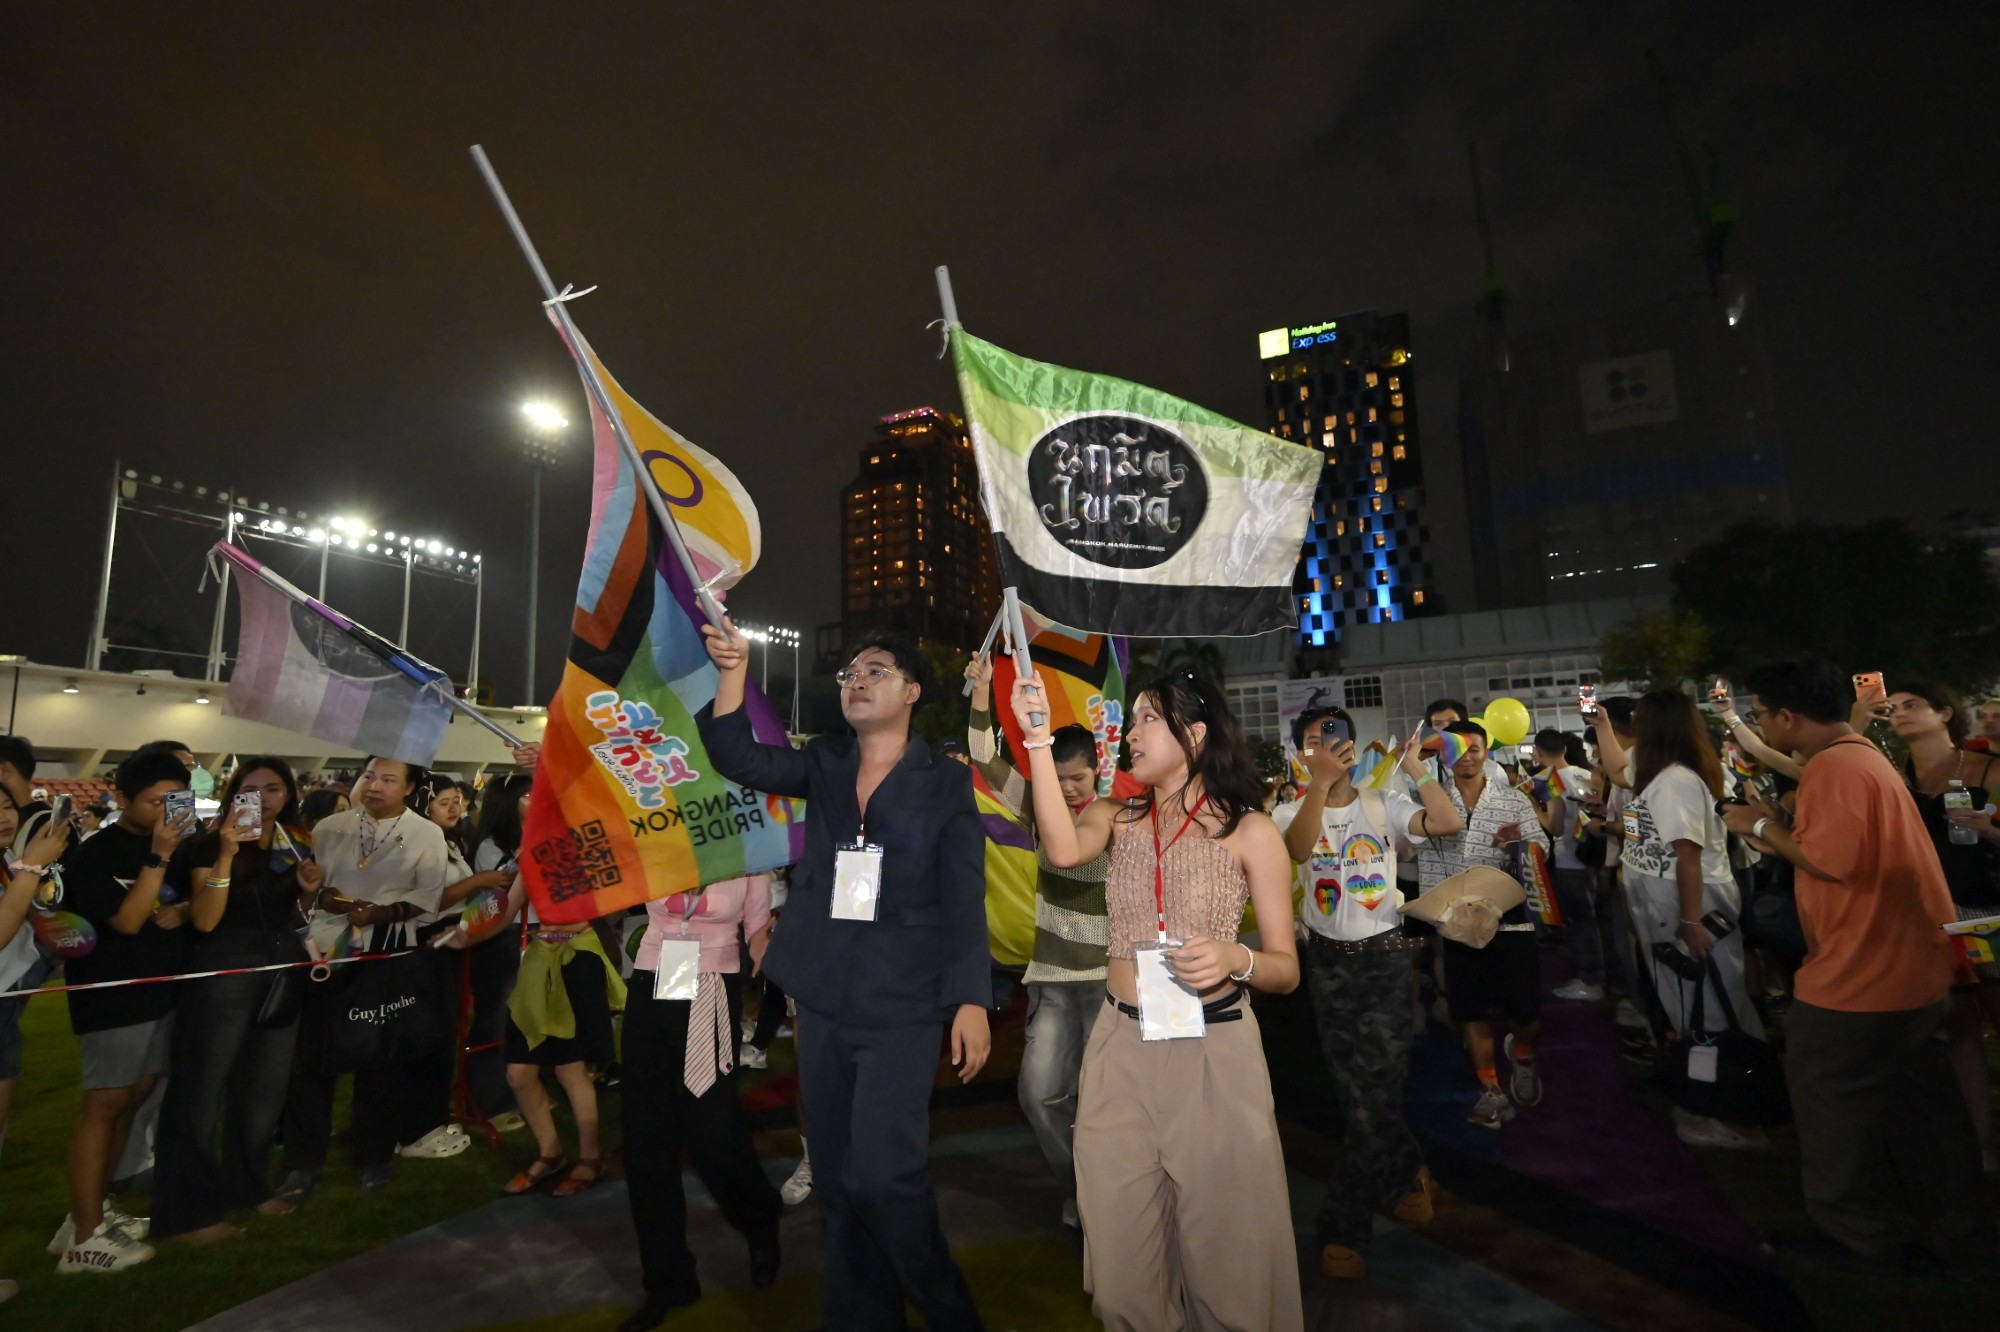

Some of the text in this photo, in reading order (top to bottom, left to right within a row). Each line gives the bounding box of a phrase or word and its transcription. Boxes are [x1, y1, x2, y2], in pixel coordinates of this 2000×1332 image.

[1291, 321, 1336, 337] Holiday Inn
[1292, 331, 1337, 349] Expess
[593, 743, 637, 795] love wins
[1343, 859, 1359, 867] LOVE
[1370, 855, 1384, 863] LOVE
[1359, 881, 1376, 889] LOVE
[1521, 852, 1545, 912] 2030
[348, 1007, 377, 1022] Guy
[67, 1250, 118, 1268] BOSTON
